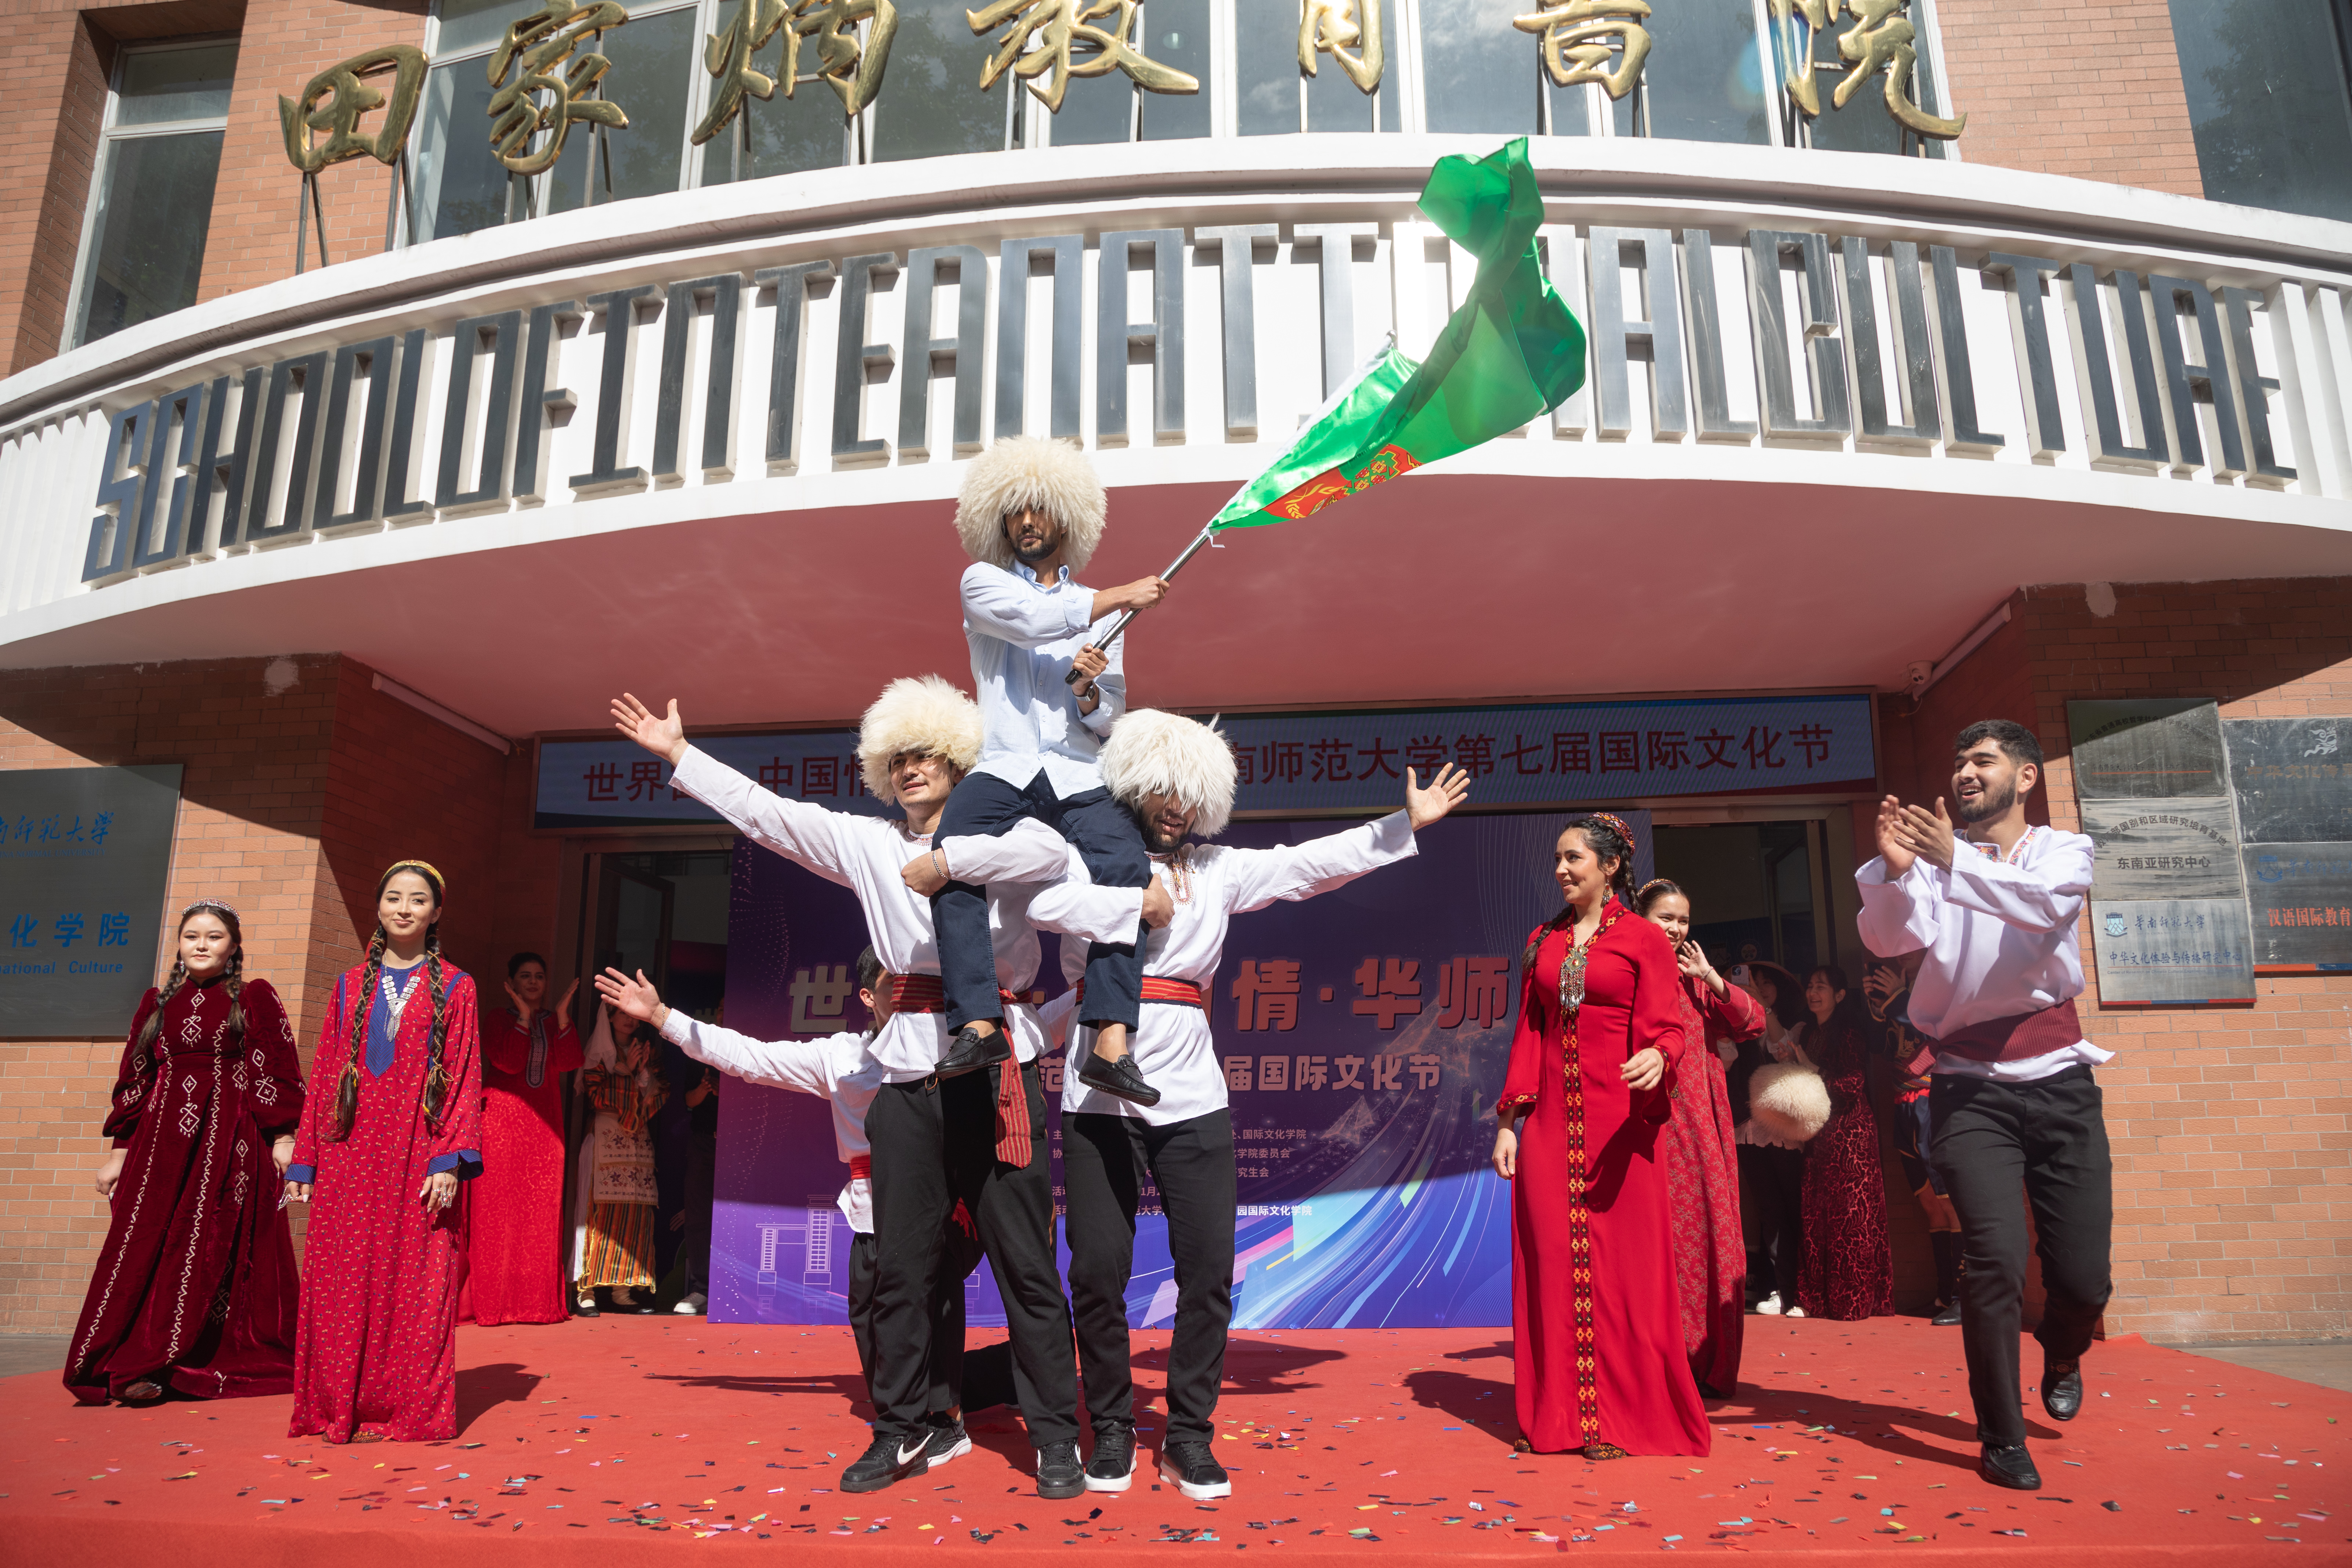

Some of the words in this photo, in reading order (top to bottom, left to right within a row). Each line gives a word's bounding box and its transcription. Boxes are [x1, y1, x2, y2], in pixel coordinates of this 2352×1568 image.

[82, 328, 436, 588] SCHOOL
[435, 300, 585, 515] OF
[1743, 228, 2299, 486] CULTURE
[583, 760, 694, 802] 世界
[17, 849, 53, 858] NORMAL
[55, 848, 105, 857] UNIVERSITY
[2117, 855, 2211, 869] 东南亚研究中心
[2268, 907, 2351, 927] 汉语国际教育
[9, 912, 130, 948] 化学院
[2109, 949, 2242, 966] 中华文化体验与传播研究中心
[0, 961, 57, 974] ational
[69, 961, 123, 974] Culture
[1223, 1054, 1441, 1092] 届国际文化节
[1236, 1167, 1269, 1177] 究生会
